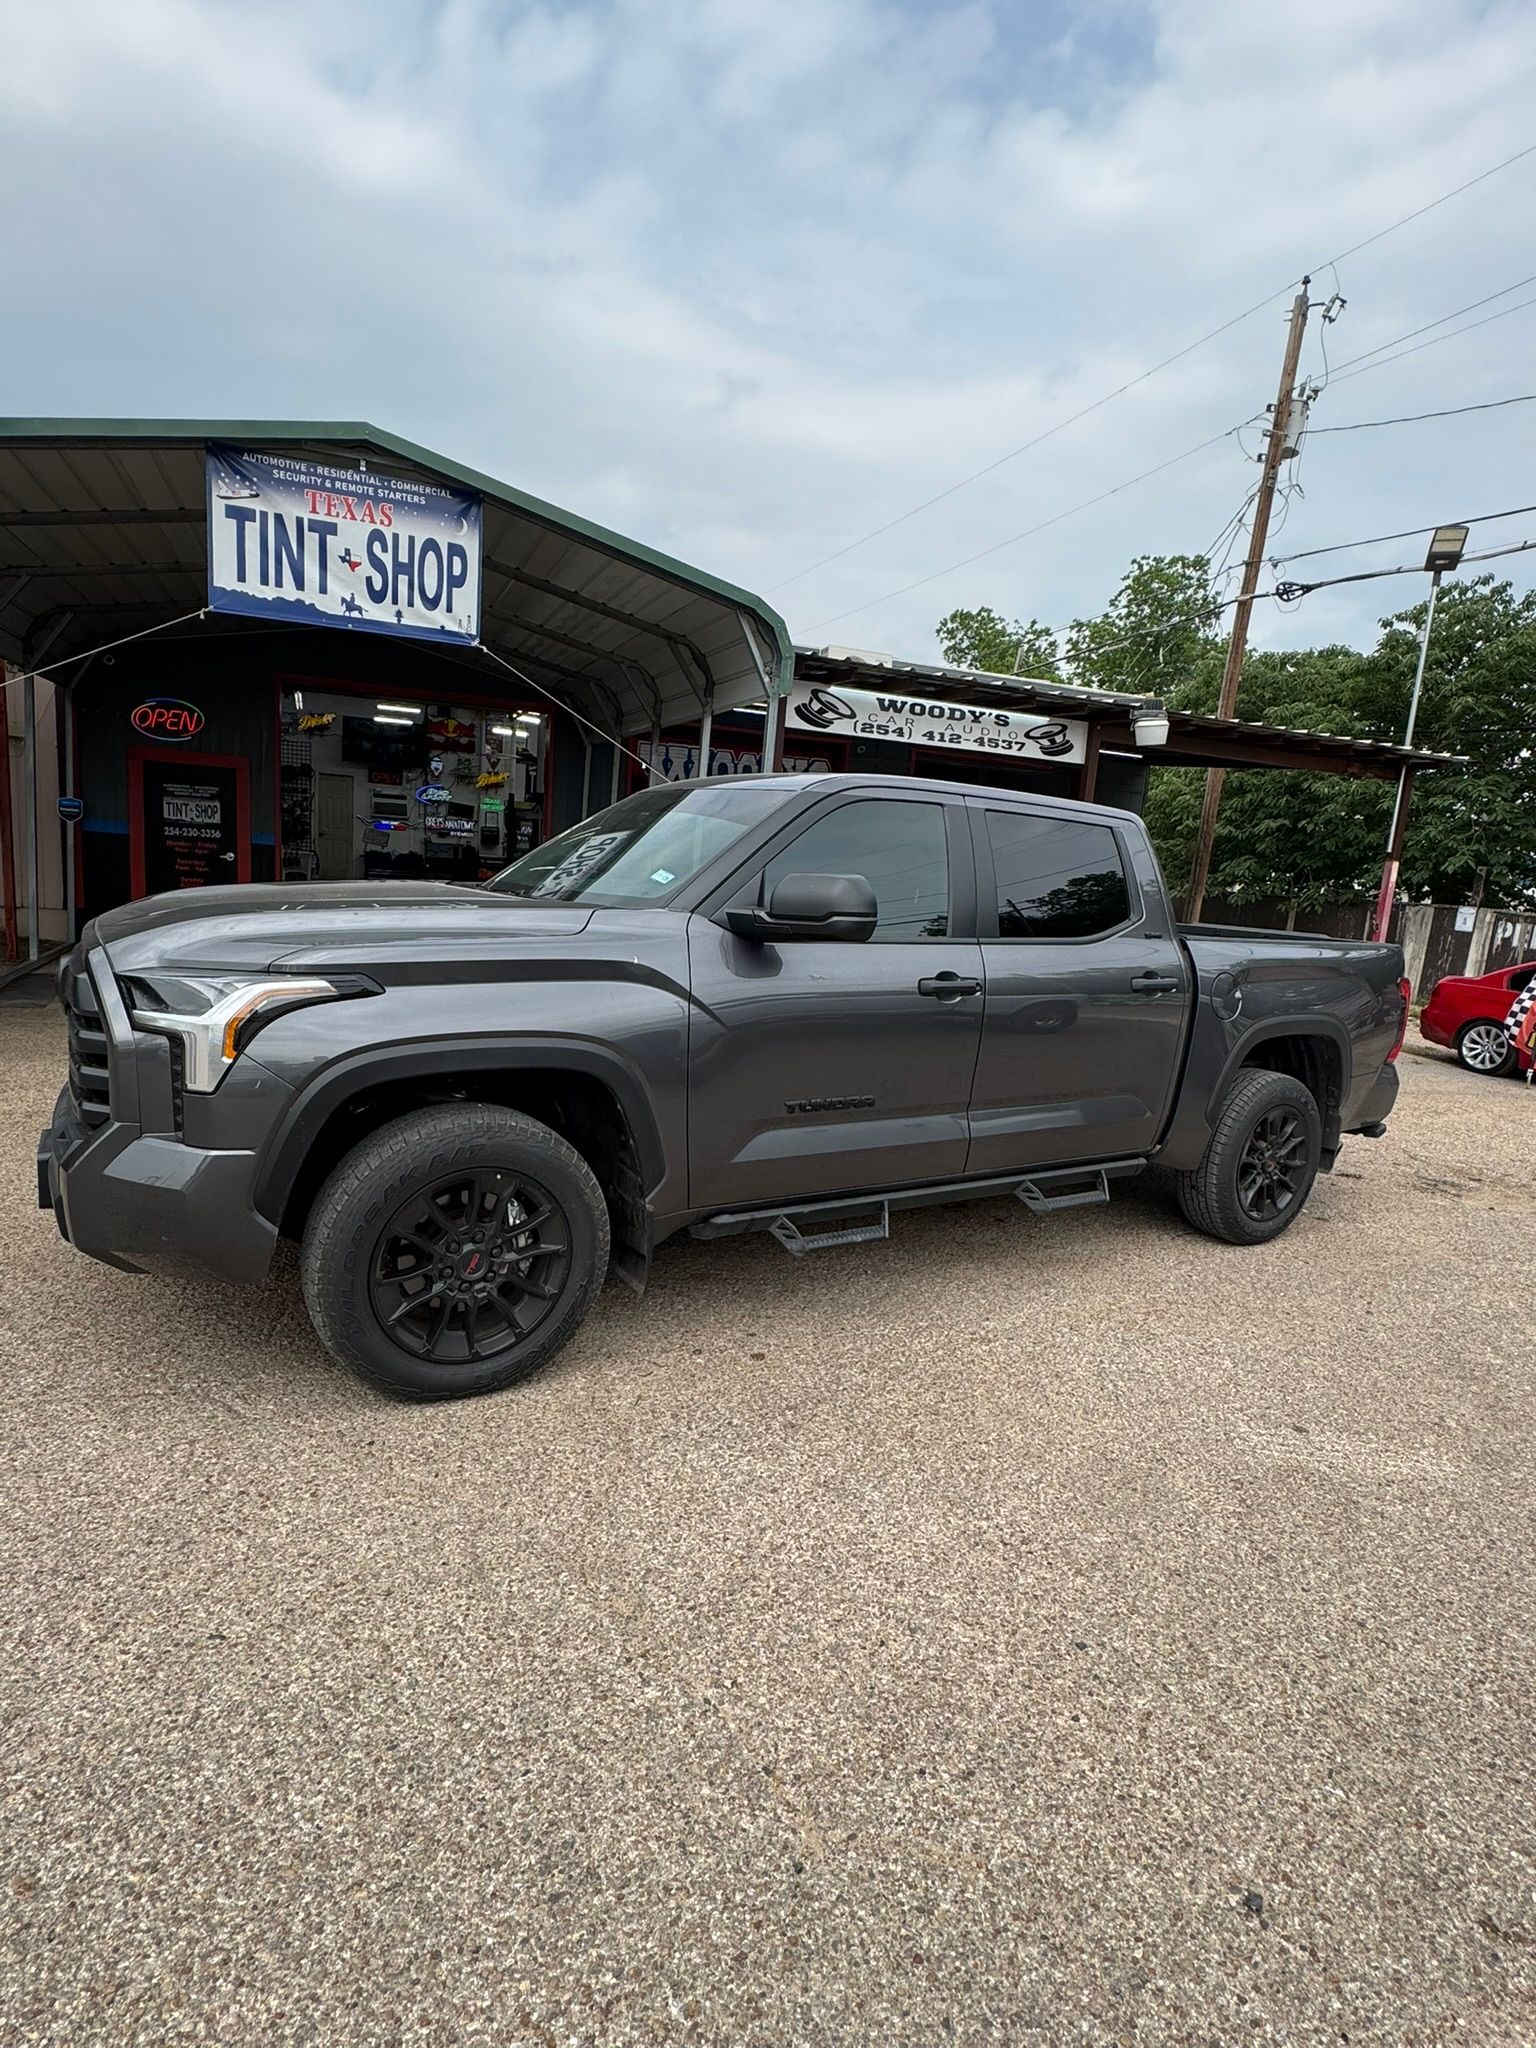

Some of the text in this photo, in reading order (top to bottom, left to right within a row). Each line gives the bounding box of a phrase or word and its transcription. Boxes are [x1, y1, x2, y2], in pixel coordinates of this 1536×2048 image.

[242, 452, 453, 499] AUTOMOTIVE RESIDENTIAL COMMERCIAL
[272, 469, 426, 505] SECURITY & REMOTE STARTERS
[304, 489, 394, 527] TEXAS
[225, 504, 468, 614] TINT SHOP
[136, 708, 198, 731] OPEN
[876, 697, 1011, 727] WOODY'S
[853, 719, 1026, 752] (254) 412-4537
[868, 713, 1018, 740] CAR AUDIO
[370, 771, 400, 785] OPEN
[165, 801, 219, 820] TINT SHOP
[163, 826, 221, 838] 254-230-3356
[783, 1095, 876, 1114] TUNDRA
